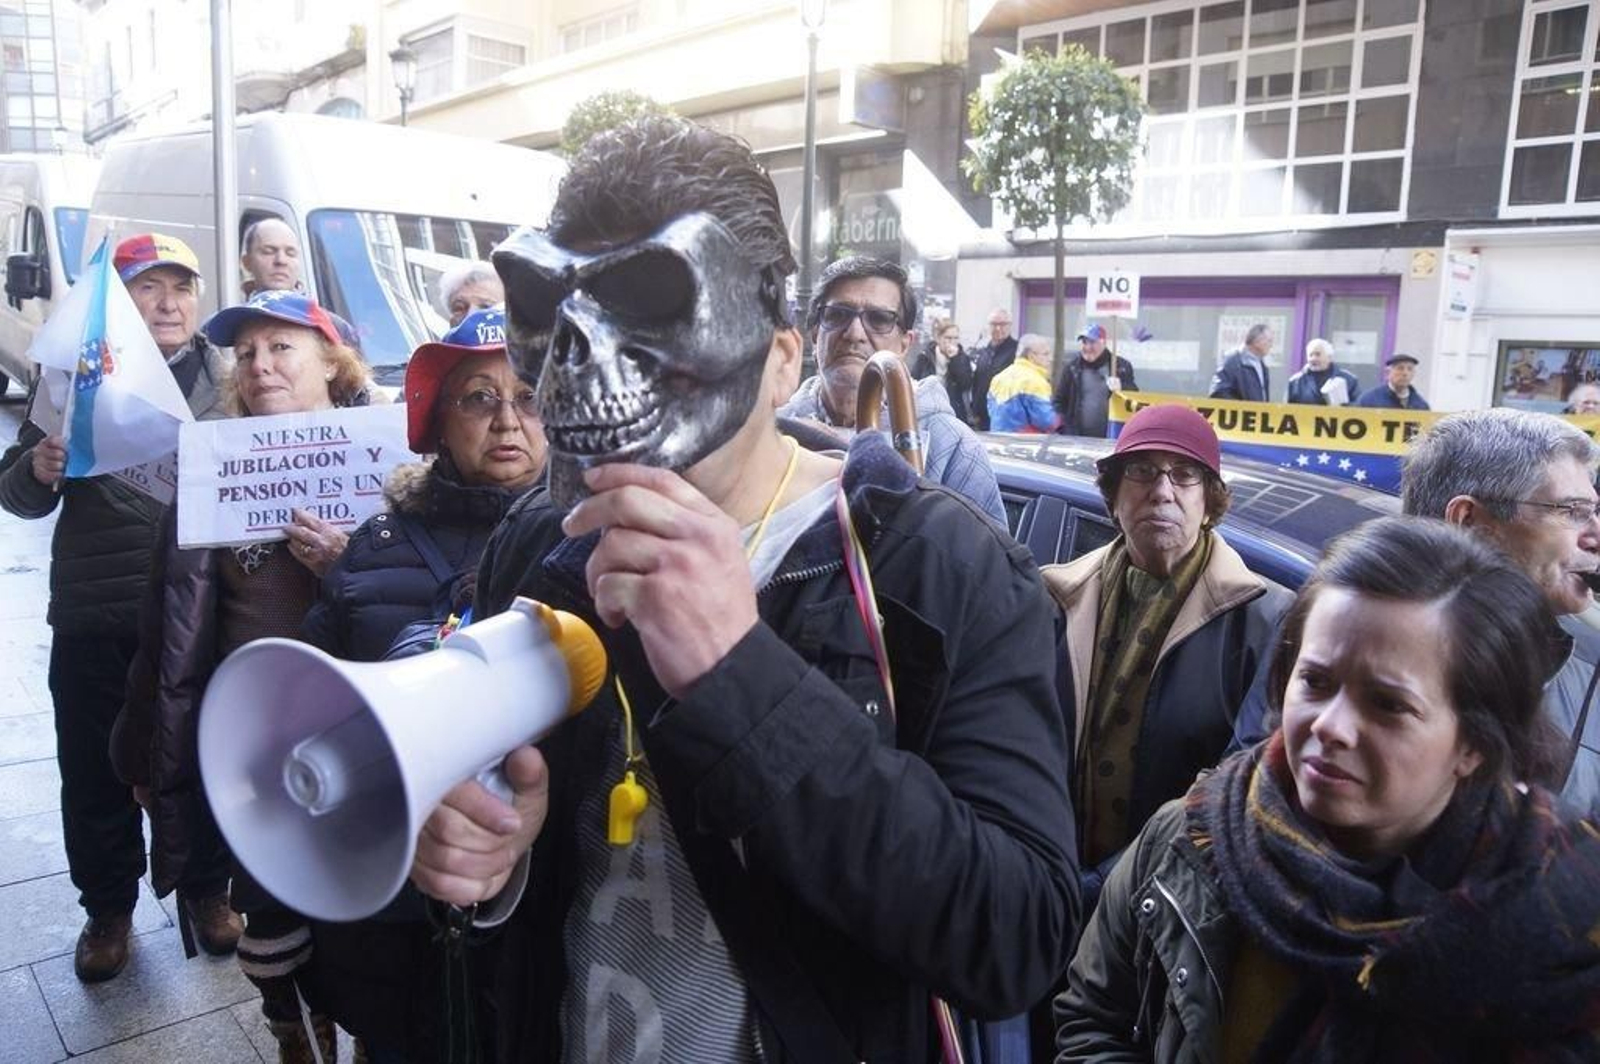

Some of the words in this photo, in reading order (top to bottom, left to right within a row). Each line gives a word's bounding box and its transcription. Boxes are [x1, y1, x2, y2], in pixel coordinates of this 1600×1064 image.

[1099, 277, 1130, 293] NO
[252, 425, 348, 448] NUESTRA
[1314, 416, 1368, 441] NO
[218, 448, 346, 478] JUBILACIÓN
[366, 447, 383, 463] Y
[218, 477, 308, 503] PENSIÓN
[318, 476, 343, 494] ES
[355, 473, 384, 491] UN
